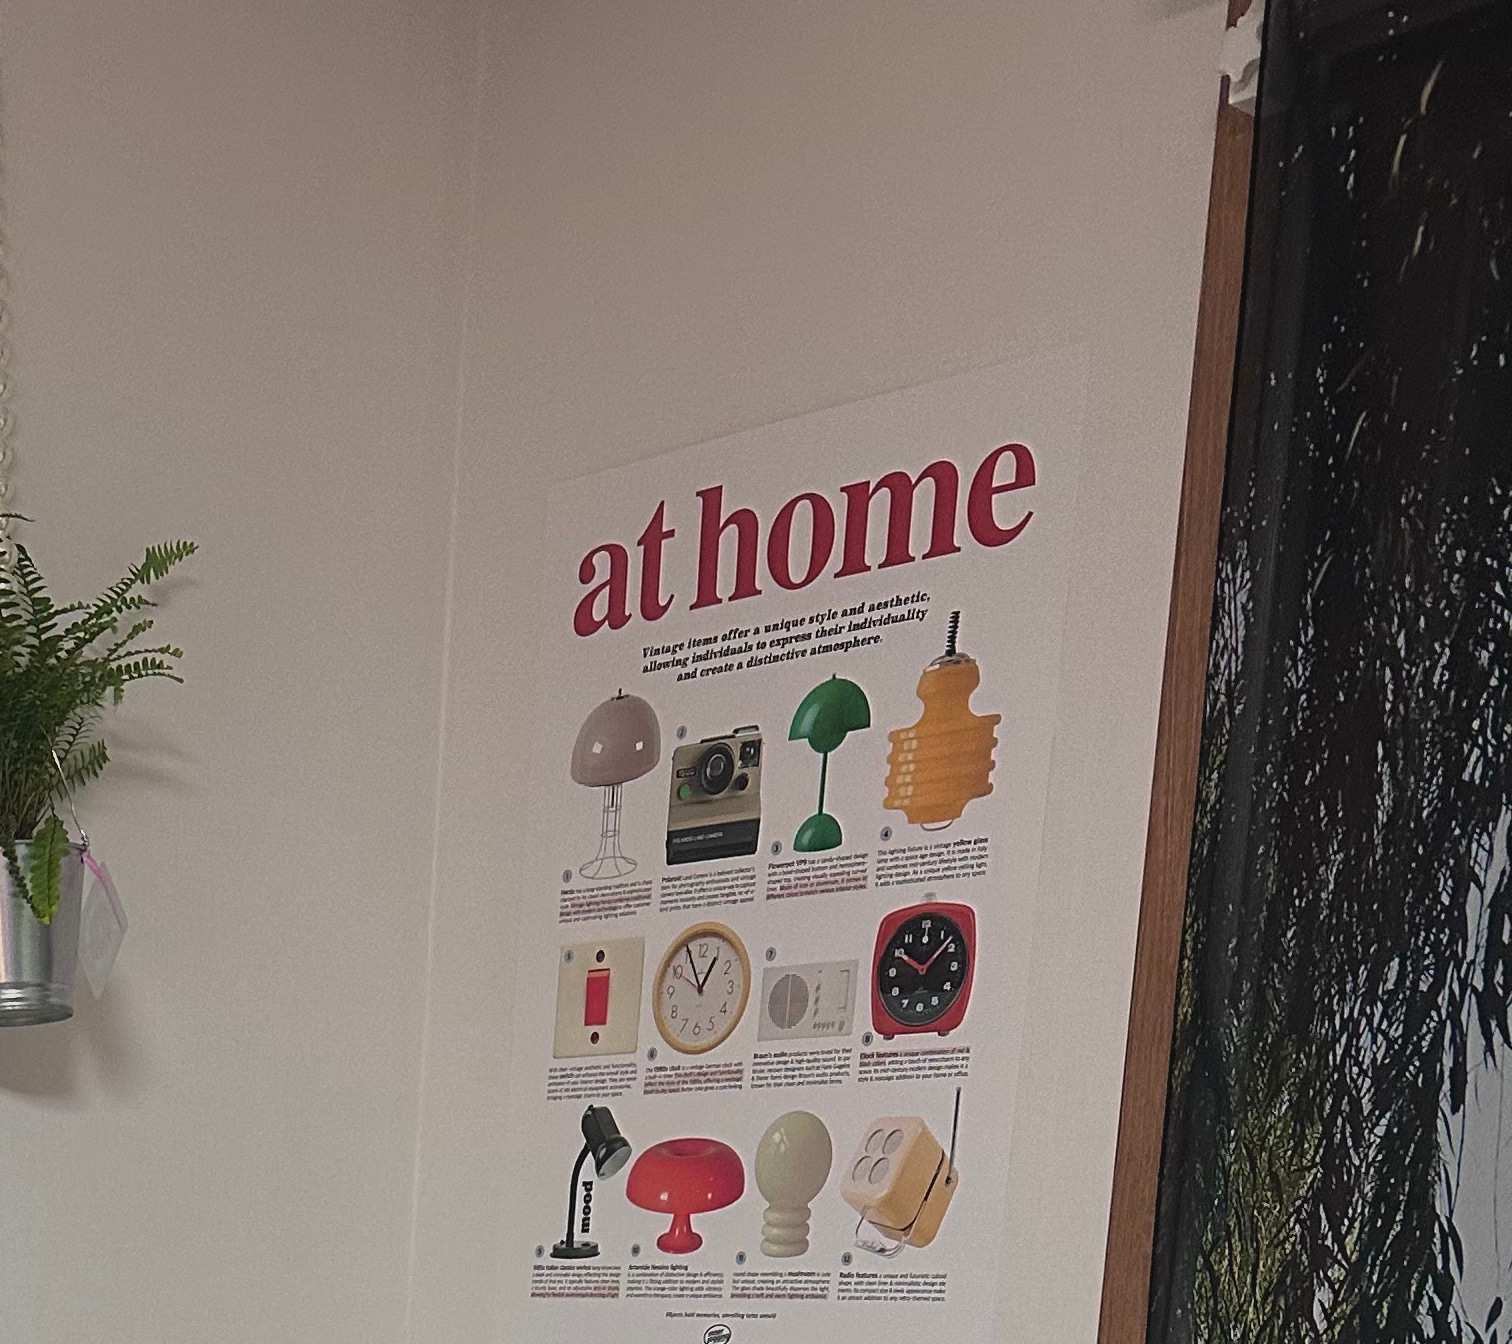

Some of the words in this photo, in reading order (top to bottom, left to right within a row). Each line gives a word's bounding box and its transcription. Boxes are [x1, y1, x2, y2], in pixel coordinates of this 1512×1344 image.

[572, 499, 676, 638] at
[688, 441, 1037, 613] home
[642, 641, 685, 660] Vintage
[687, 636, 718, 650] items
[720, 628, 750, 644] offer
[753, 626, 760, 636] a
[764, 618, 806, 634] unique
[808, 608, 838, 627] style
[841, 602, 865, 620] and
[868, 590, 931, 613] aesthetic,
[642, 656, 690, 674] allowing
[691, 642, 754, 665] individuals
[756, 640, 768, 652] to
[769, 631, 813, 649] express
[815, 622, 846, 640] their
[847, 608, 928, 634] individuality
[676, 666, 698, 682] and
[700, 662, 734, 678] create
[736, 661, 744, 671] a
[746, 646, 808, 668] distinctive
[810, 632, 883, 656] atmosphere.
[698, 943, 709, 958] 12
[904, 934, 912, 943] 11
[673, 964, 683, 979] 10
[581, 1180, 593, 1233] mood
